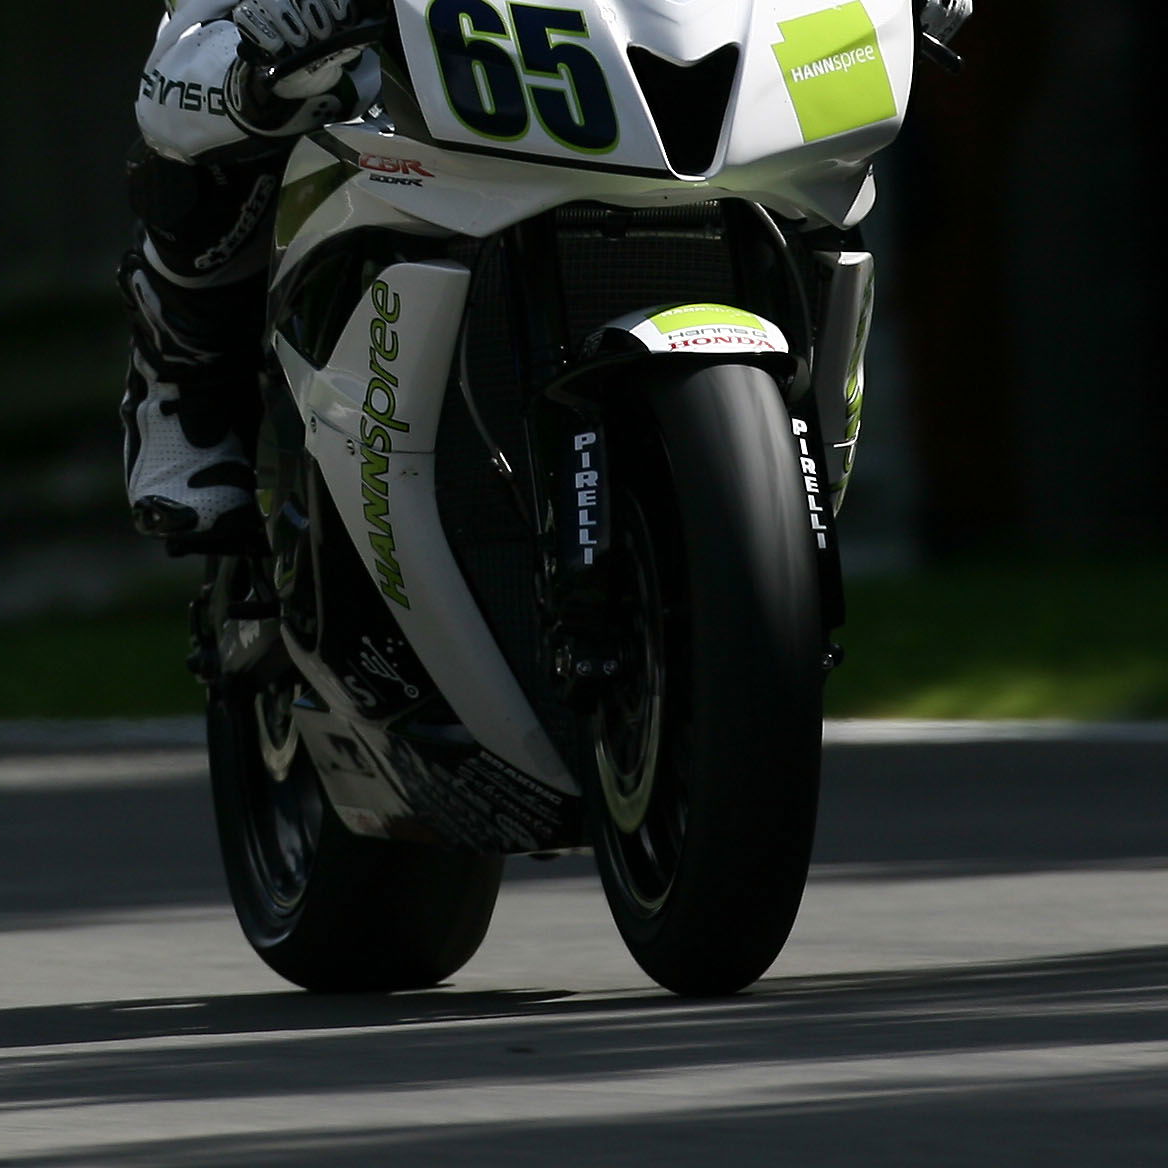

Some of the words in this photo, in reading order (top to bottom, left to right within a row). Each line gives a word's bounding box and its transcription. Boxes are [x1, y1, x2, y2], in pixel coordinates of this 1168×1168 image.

[789, 44, 877, 83] HANNspree
[358, 153, 435, 178] CBR
[668, 336, 775, 351] HONDA
[360, 279, 412, 611] HANNspree
[791, 417, 828, 550] PIRELLI
[574, 432, 598, 565] PIRELLI
